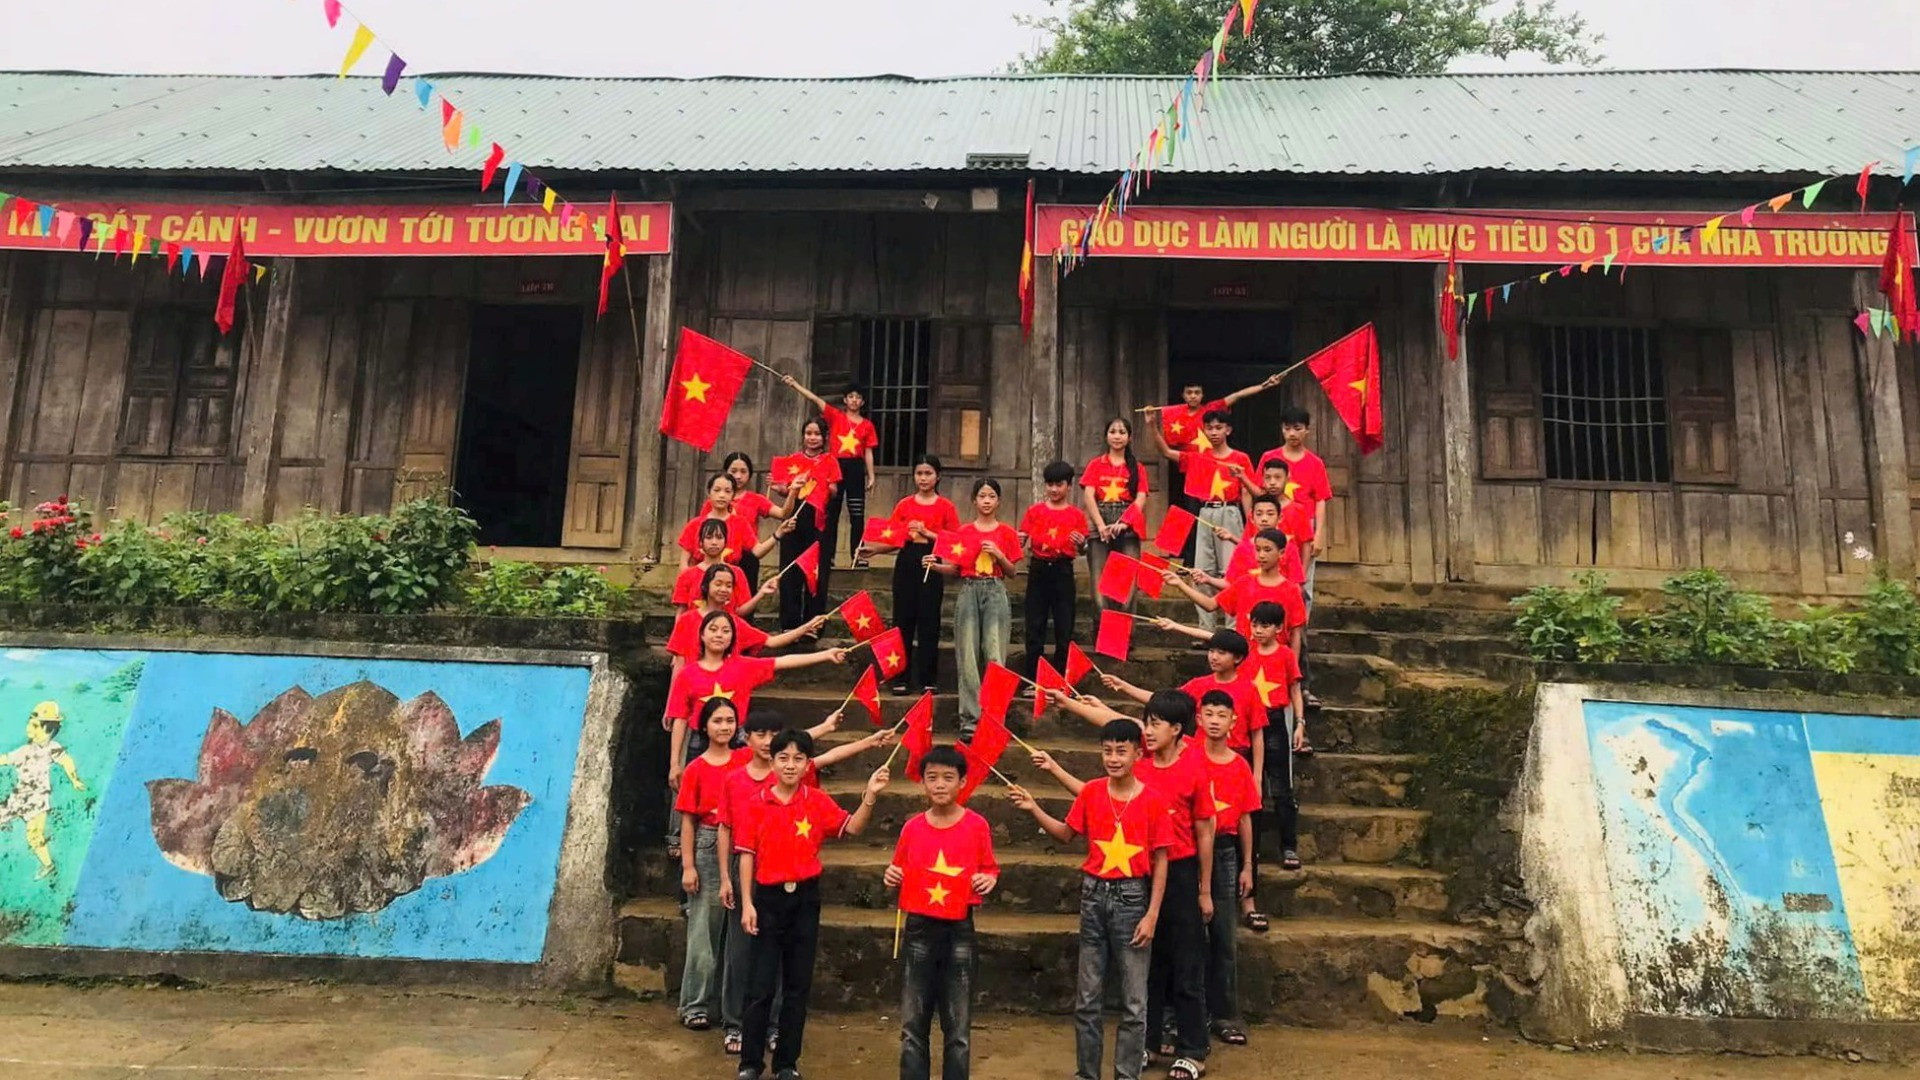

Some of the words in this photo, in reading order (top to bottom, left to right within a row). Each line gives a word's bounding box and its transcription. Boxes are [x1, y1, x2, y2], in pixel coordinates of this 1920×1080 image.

[161, 210, 258, 242] CÁNH
[294, 215, 388, 243] VƯƠN
[400, 211, 453, 243] TỚI
[466, 214, 583, 243] TƯƠNG
[1133, 220, 1190, 253] DỤC
[1199, 215, 1259, 248] LÀM
[1269, 215, 1357, 250] NGƯỜI
[1366, 217, 1402, 250] LÀ
[1410, 223, 1476, 258] MỤC
[1484, 219, 1548, 253] TIÊU
[1557, 216, 1596, 254] SỐ
[1605, 227, 1618, 256] 1
[1632, 218, 1692, 255] CỦA
[1769, 221, 1890, 256] TRƯỜNG
